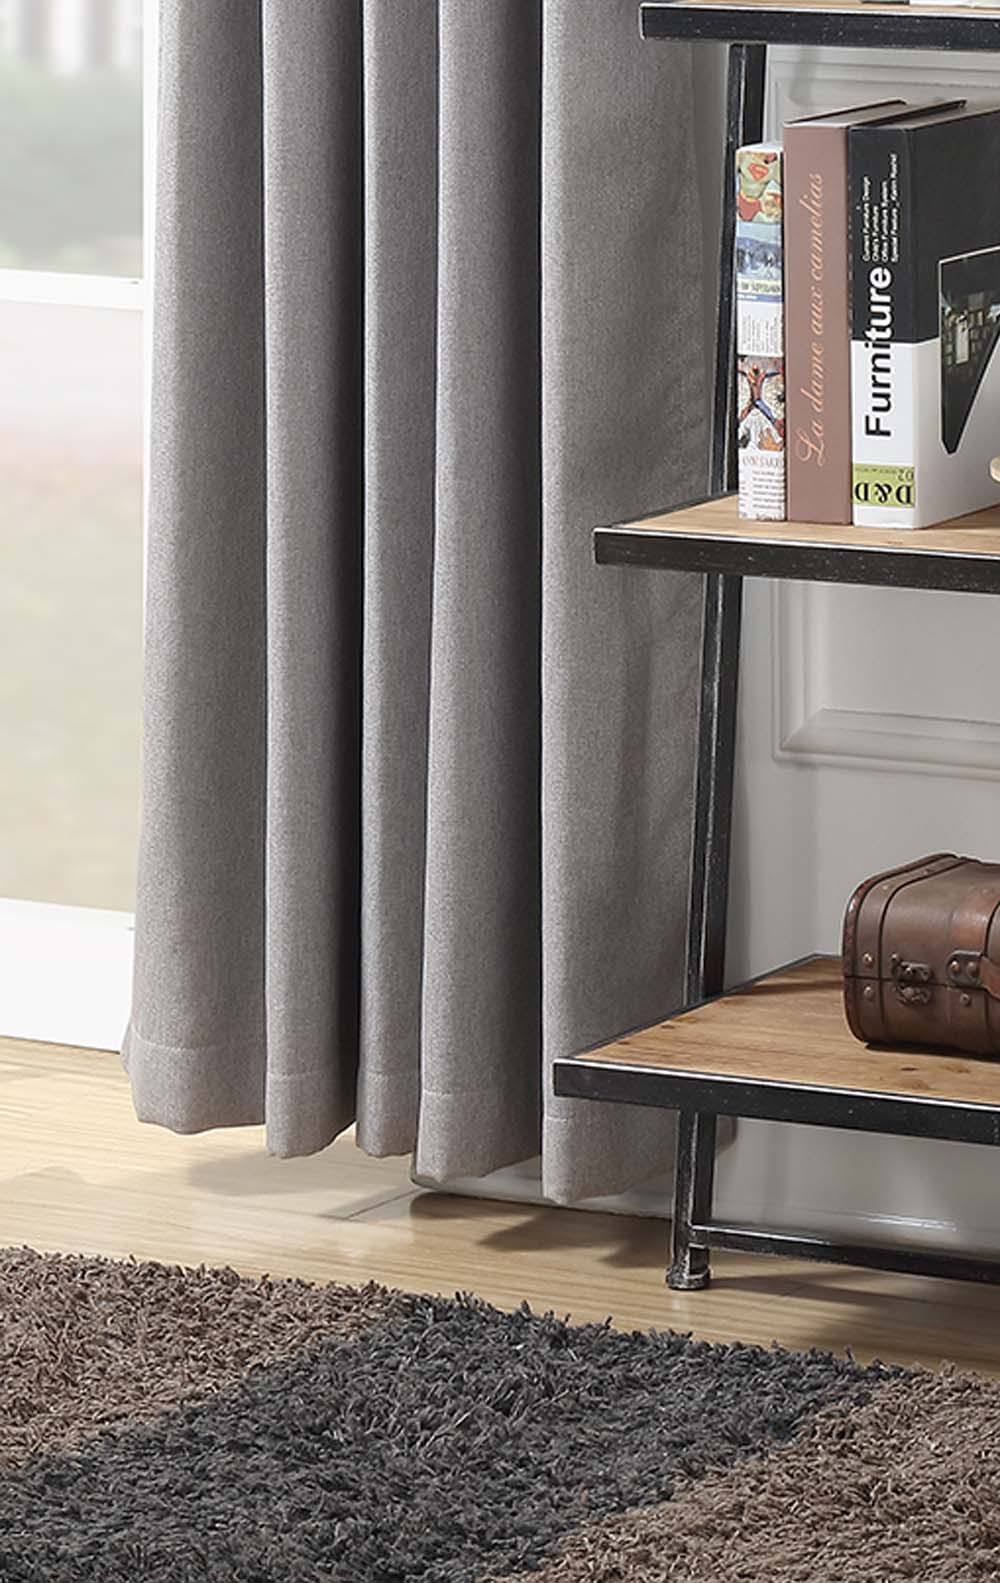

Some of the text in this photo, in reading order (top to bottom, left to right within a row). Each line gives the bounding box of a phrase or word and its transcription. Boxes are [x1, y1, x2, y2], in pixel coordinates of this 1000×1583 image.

[795, 173, 827, 467] La dame aux camelias
[864, 266, 892, 437] Furniture
[855, 482, 912, 505] D&D
